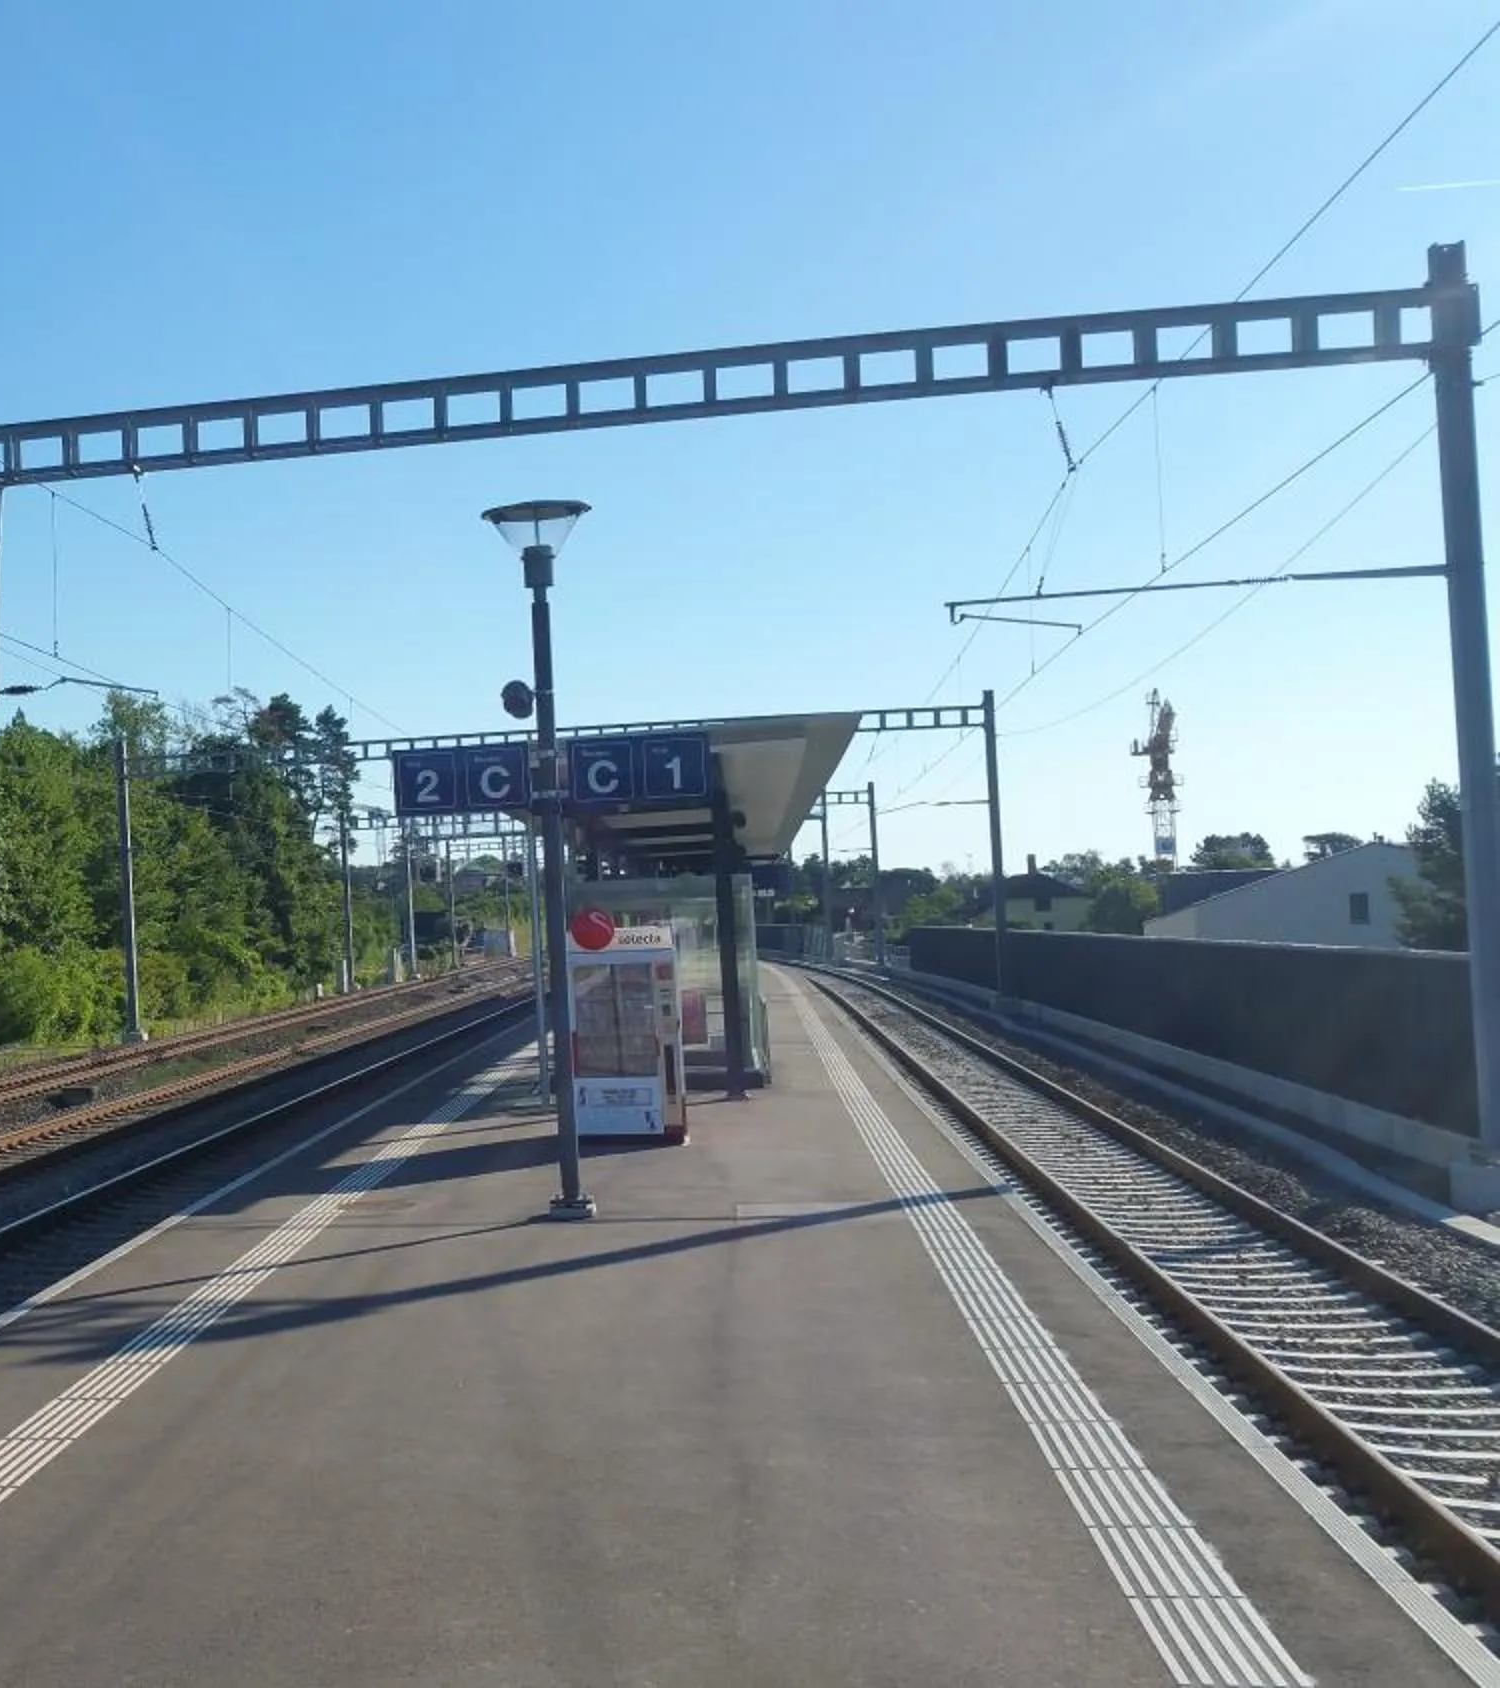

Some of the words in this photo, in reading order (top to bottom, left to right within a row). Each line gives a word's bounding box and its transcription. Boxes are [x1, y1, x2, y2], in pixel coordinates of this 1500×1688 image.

[416, 769, 440, 802] 2
[480, 765, 511, 799] C
[588, 760, 619, 793] C
[665, 755, 683, 790] 1
